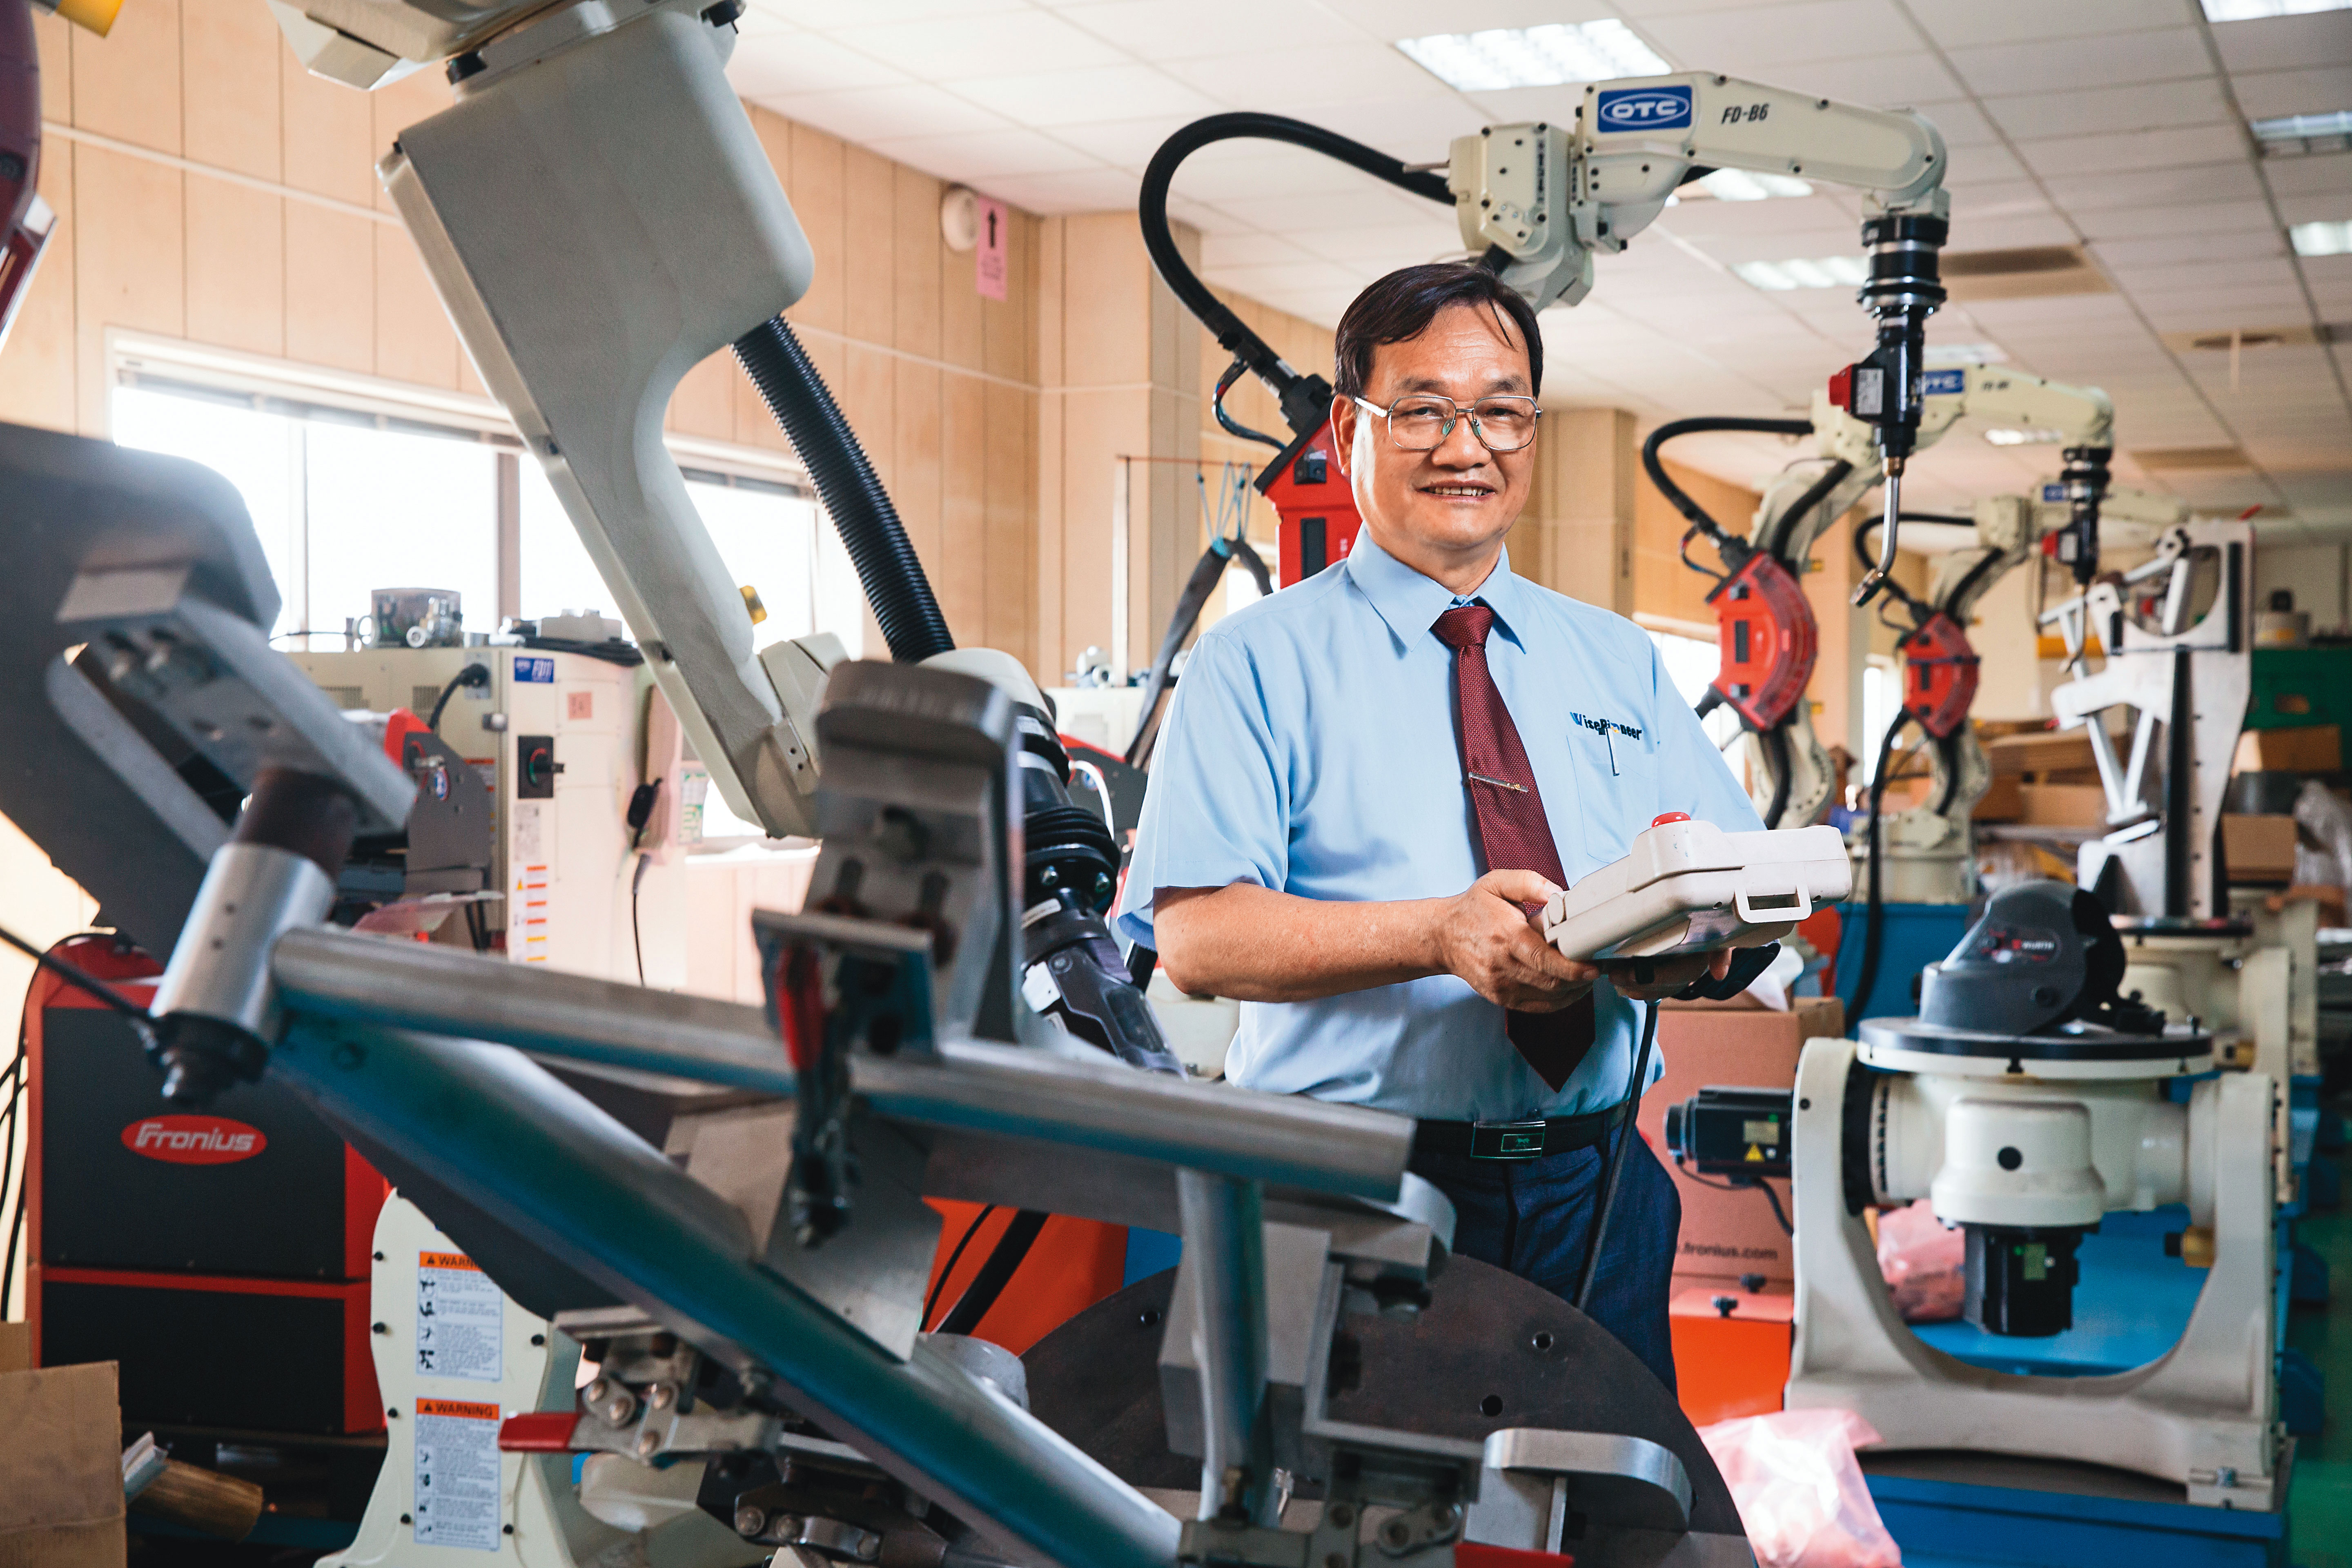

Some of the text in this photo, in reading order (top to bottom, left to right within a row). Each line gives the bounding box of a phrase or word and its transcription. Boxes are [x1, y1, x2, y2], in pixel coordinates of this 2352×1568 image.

[1611, 100, 1678, 119] OTC
[1721, 102, 1770, 125] FD-B6
[135, 1122, 256, 1152] Fronius
[1677, 1242, 1778, 1260] .fronius.com
[436, 1402, 493, 1418] WARNING
